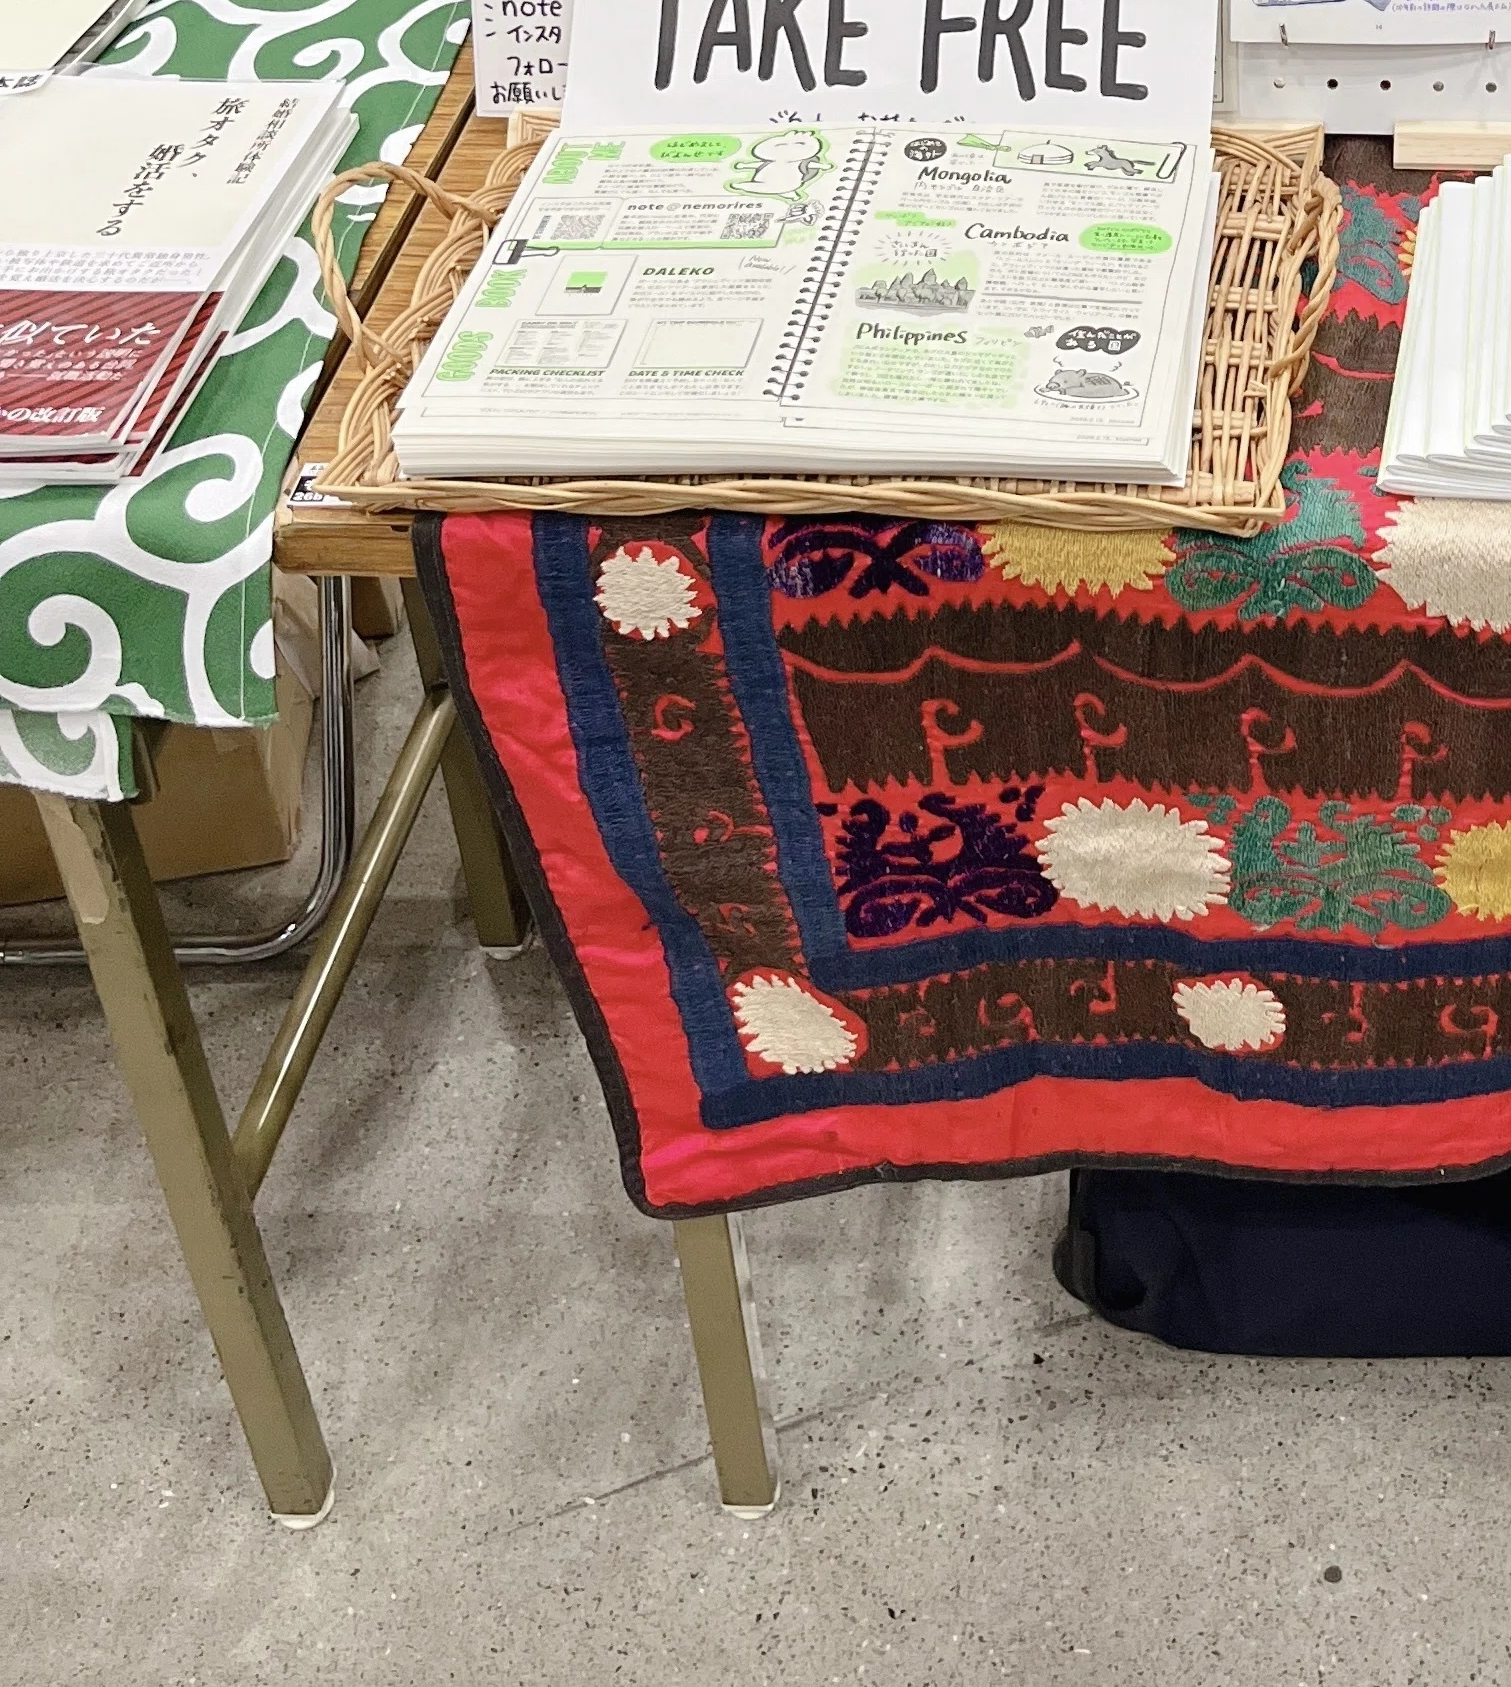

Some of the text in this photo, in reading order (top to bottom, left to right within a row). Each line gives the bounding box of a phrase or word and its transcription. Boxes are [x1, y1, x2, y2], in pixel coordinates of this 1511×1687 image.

[506, 24, 562, 44] インスタ
[542, 142, 594, 185] ABOUT
[917, 165, 1013, 186] Mongolia
[96, 143, 185, 236] 婚活をする
[627, 203, 665, 211] note
[963, 222, 1070, 243] Cambodia
[642, 267, 715, 276] DALEKO
[474, 267, 529, 308] BOOK
[856, 322, 969, 346] Philippines
[435, 330, 495, 382] GOODS
[489, 368, 607, 378] PACKING CHECKLIST
